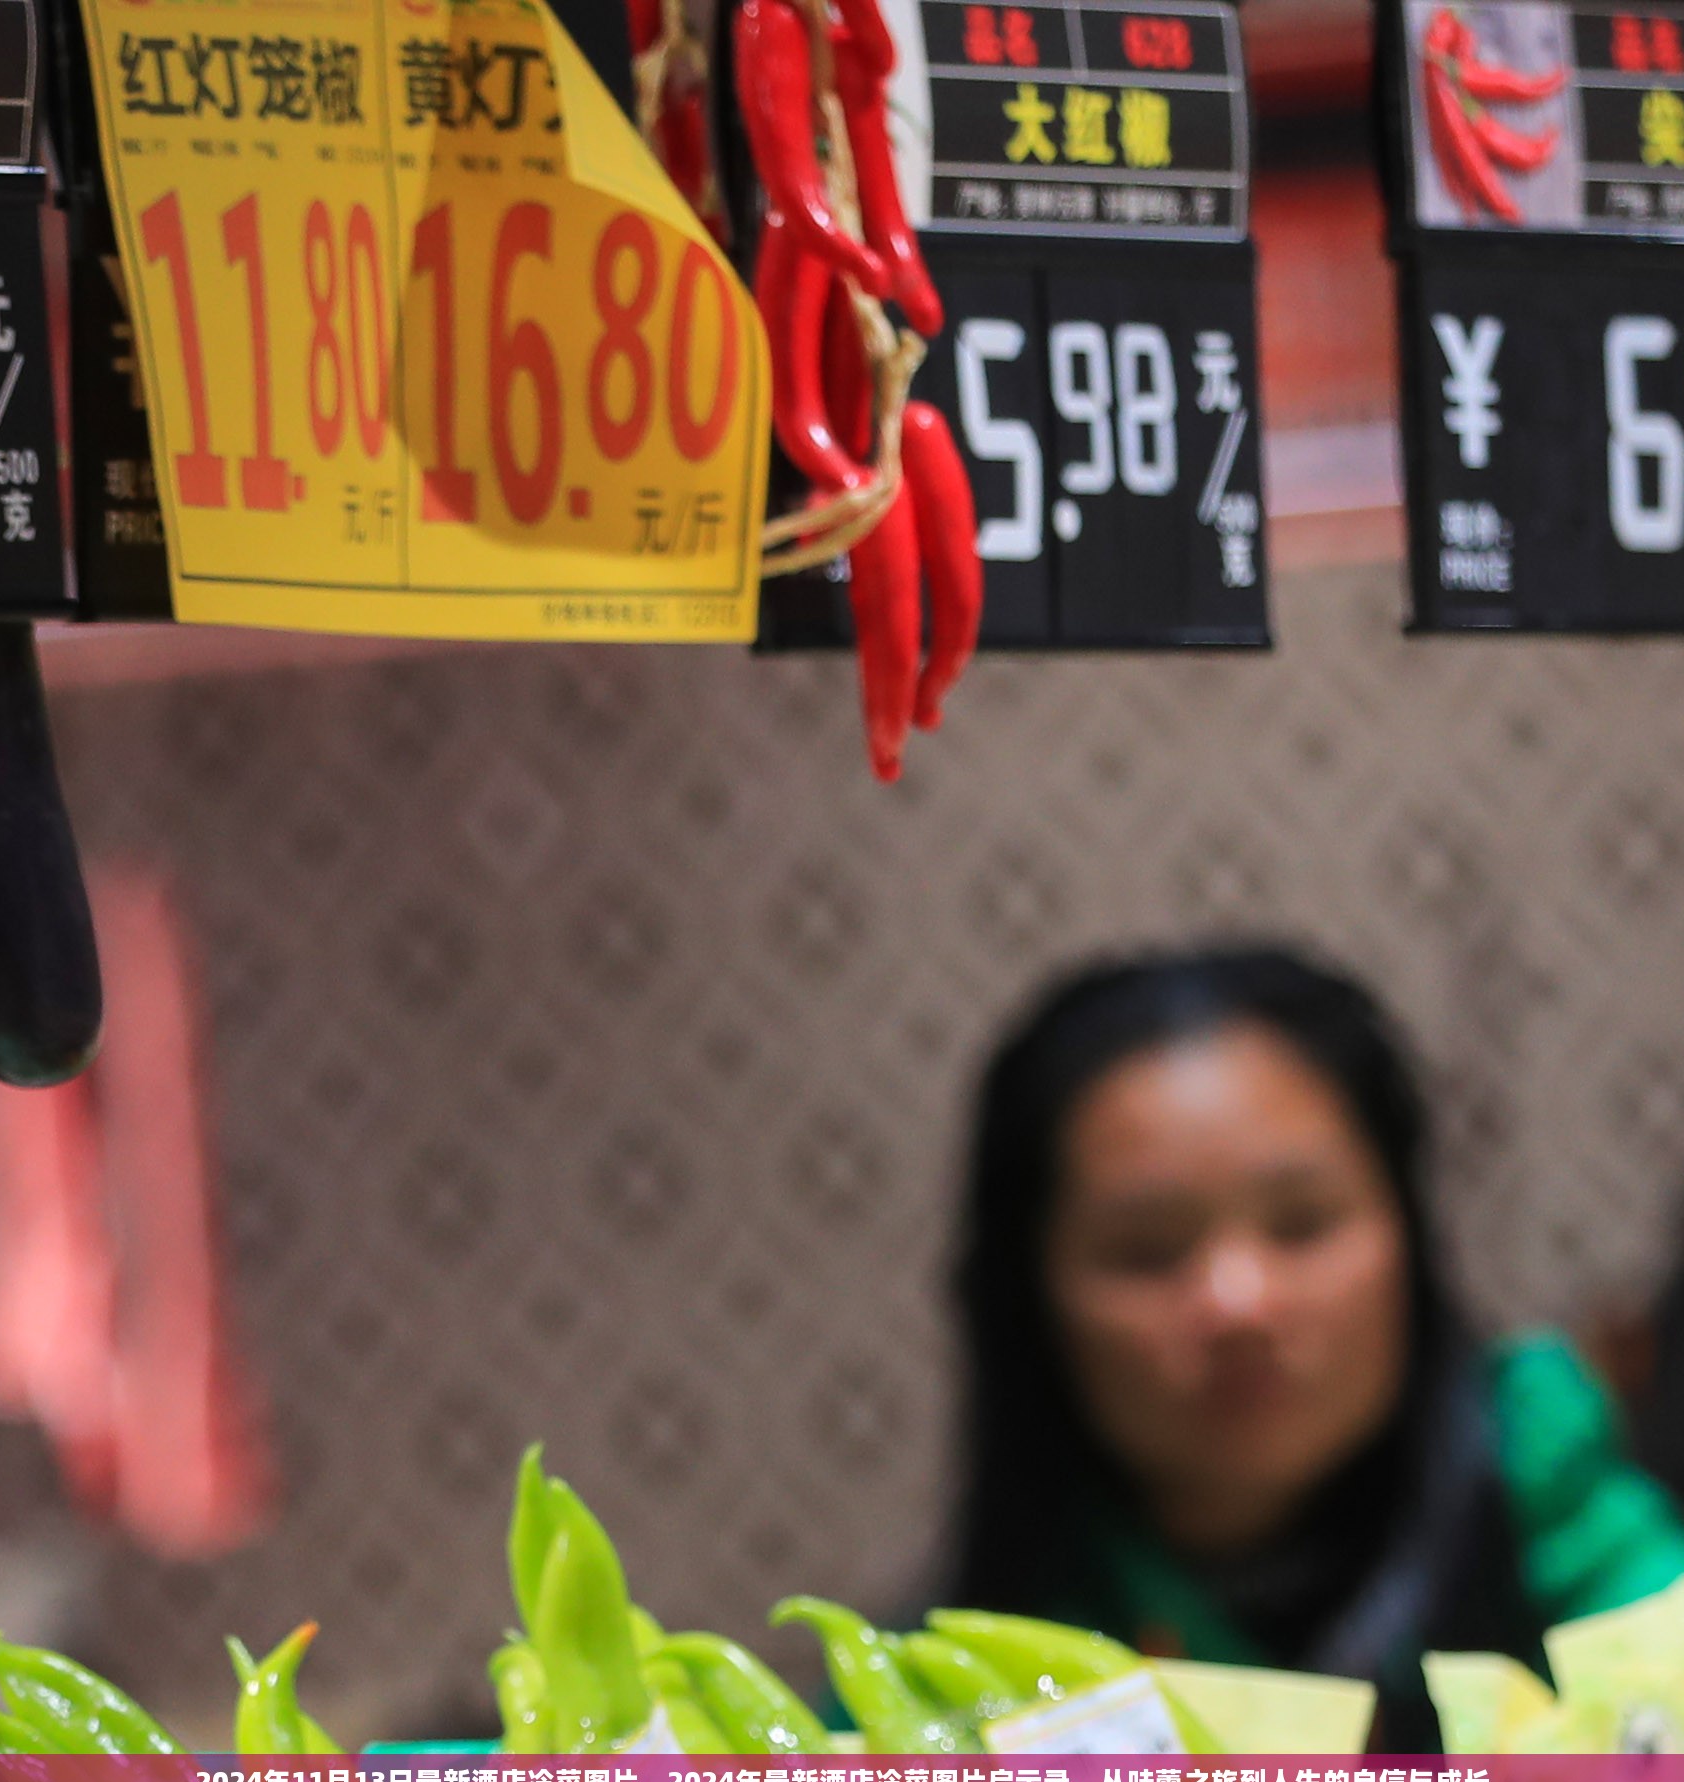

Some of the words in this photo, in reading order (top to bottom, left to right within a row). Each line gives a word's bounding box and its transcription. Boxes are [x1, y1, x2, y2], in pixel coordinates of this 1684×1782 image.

[120, 33, 364, 126] 红灯笼椒
[1002, 82, 1173, 169] 大红椒
[412, 201, 740, 525] 16.80
[955, 317, 1178, 563] 5.98
